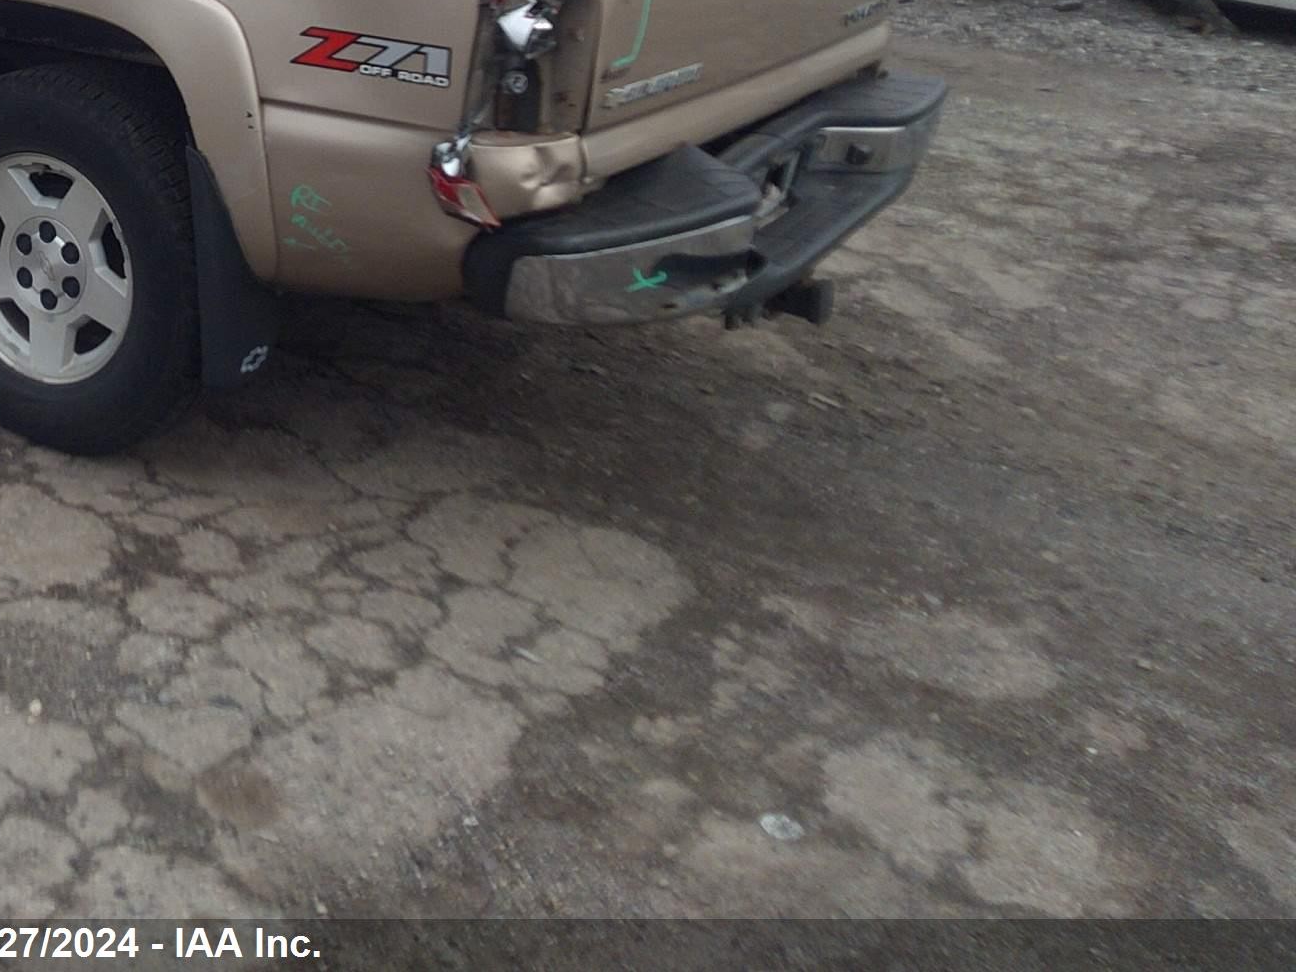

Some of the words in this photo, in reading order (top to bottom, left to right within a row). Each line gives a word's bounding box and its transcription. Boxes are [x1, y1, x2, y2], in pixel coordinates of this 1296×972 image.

[289, 26, 452, 79] Z71
[359, 64, 393, 78] OFF
[397, 70, 450, 87] ROAD
